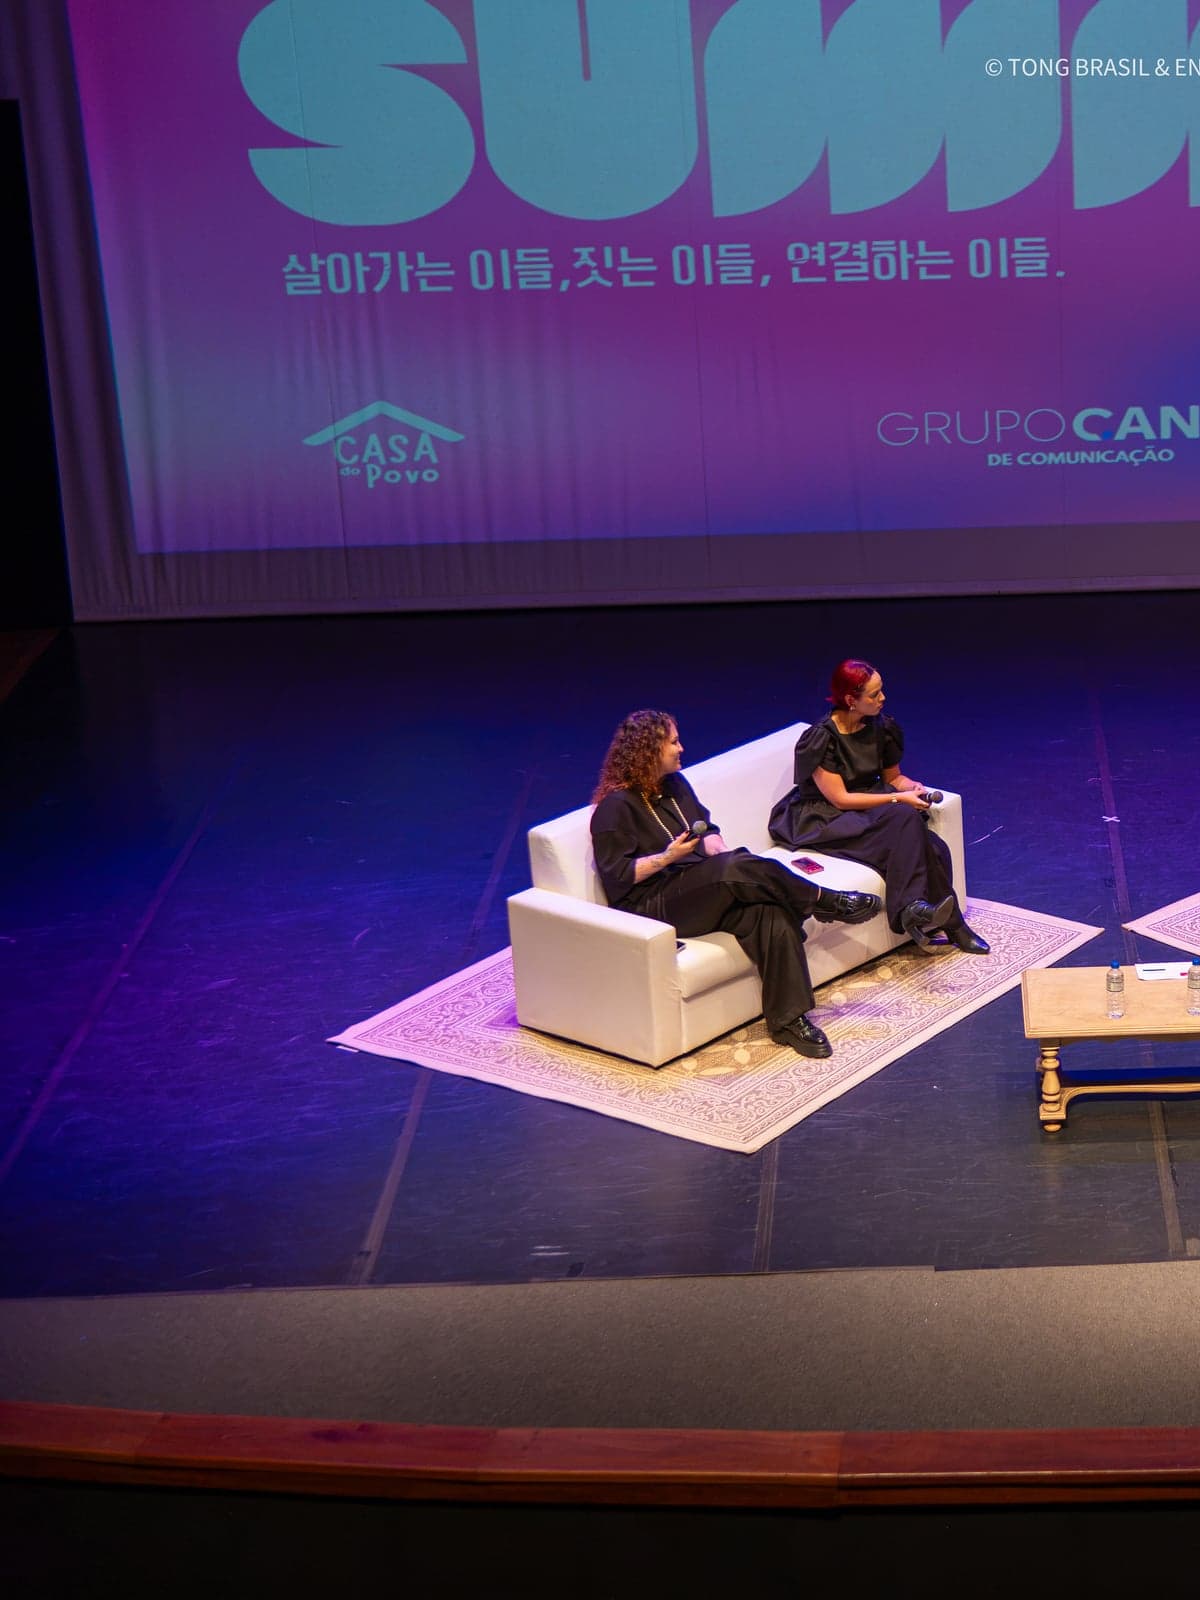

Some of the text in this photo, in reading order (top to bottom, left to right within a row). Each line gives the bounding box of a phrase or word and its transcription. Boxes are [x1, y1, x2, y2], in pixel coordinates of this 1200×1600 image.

[282, 250, 455, 295] 살아가는
[671, 243, 771, 287] 이들,
[787, 239, 954, 283] 연결하는
[968, 237, 1066, 279] 이들.
[335, 433, 439, 465] CASA
[987, 445, 1175, 466] DE COMUNICAÇÃO
[339, 466, 360, 476] do
